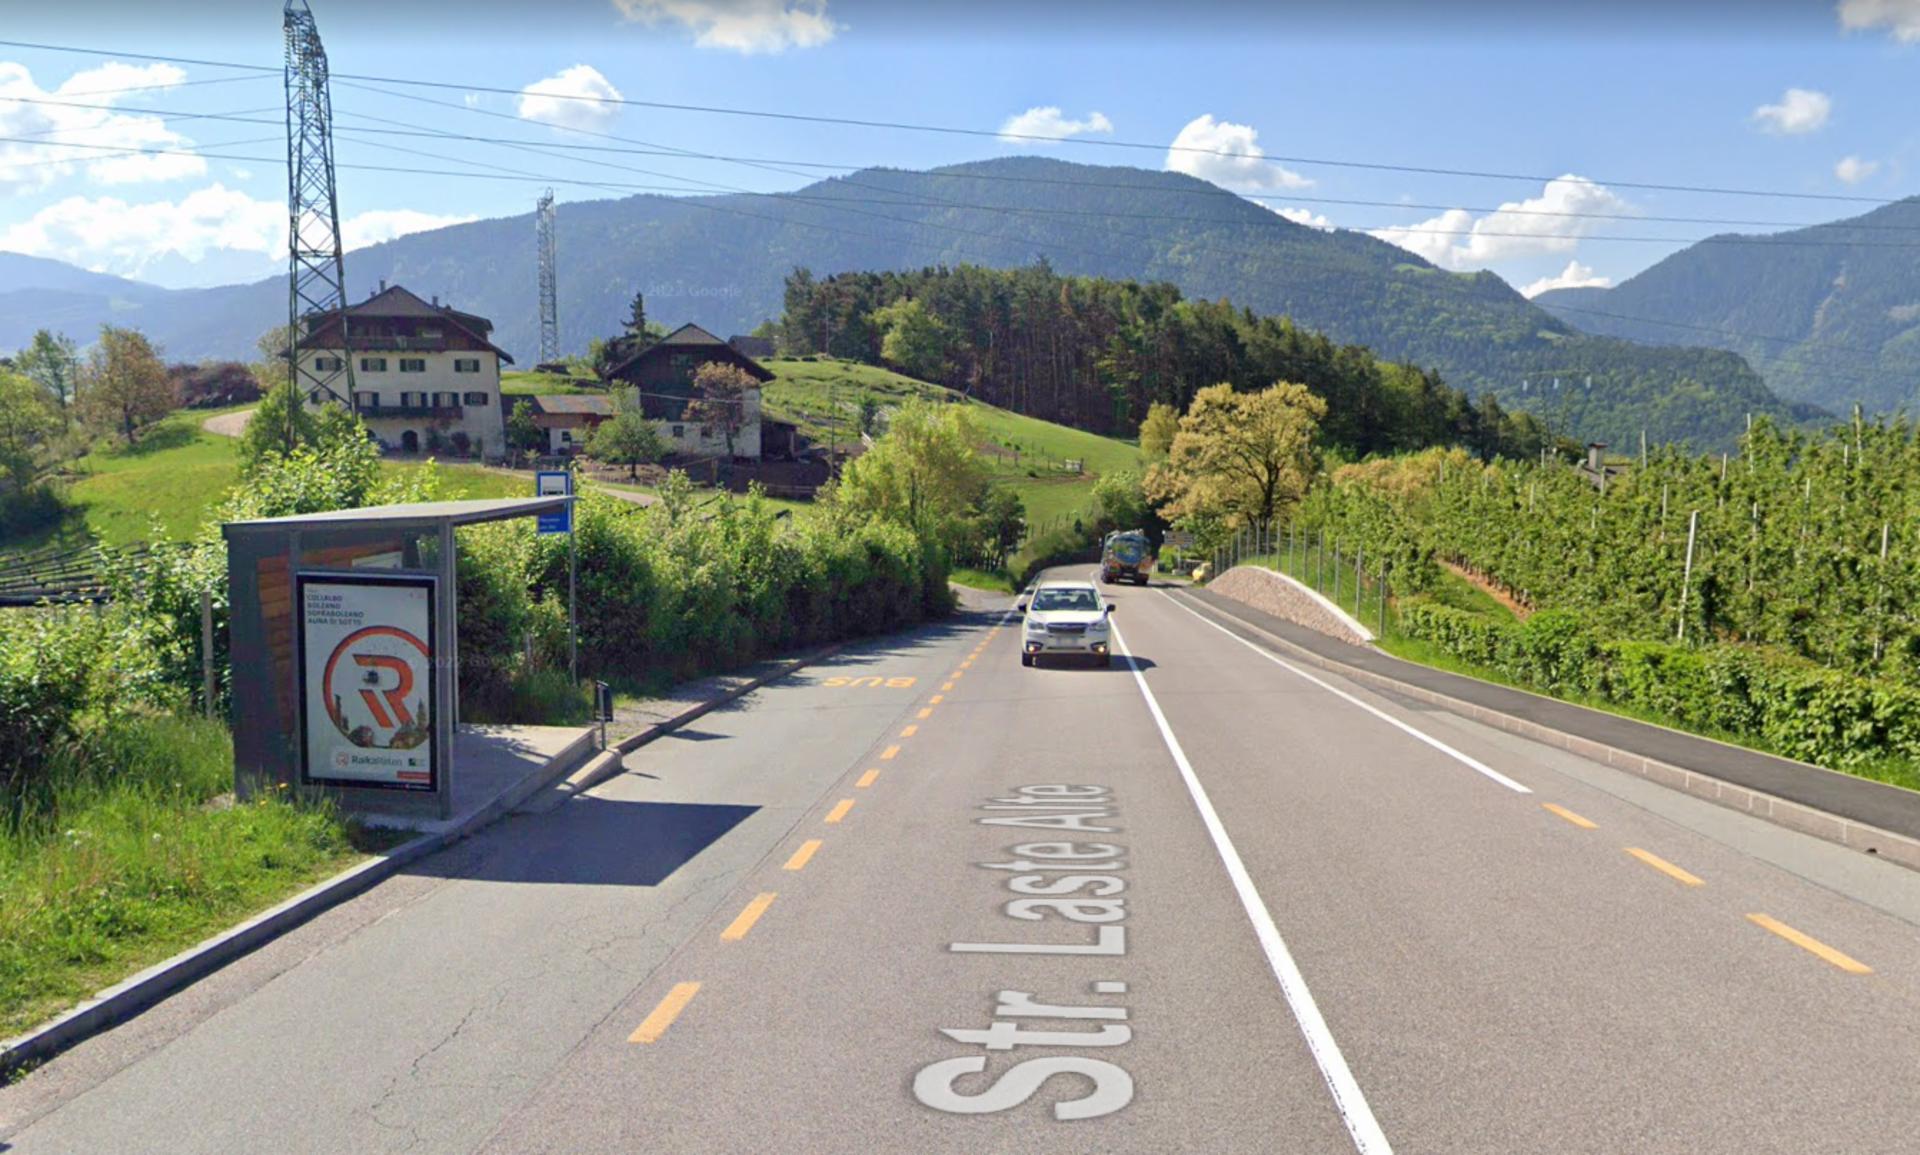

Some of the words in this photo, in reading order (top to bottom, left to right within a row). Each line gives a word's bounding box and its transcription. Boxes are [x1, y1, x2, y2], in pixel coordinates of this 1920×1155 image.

[307, 594, 343, 602] COLLALBO
[307, 602, 341, 610] BOLZANO
[307, 610, 364, 618] SOPRABOLZANO
[823, 676, 916, 689] BUS
